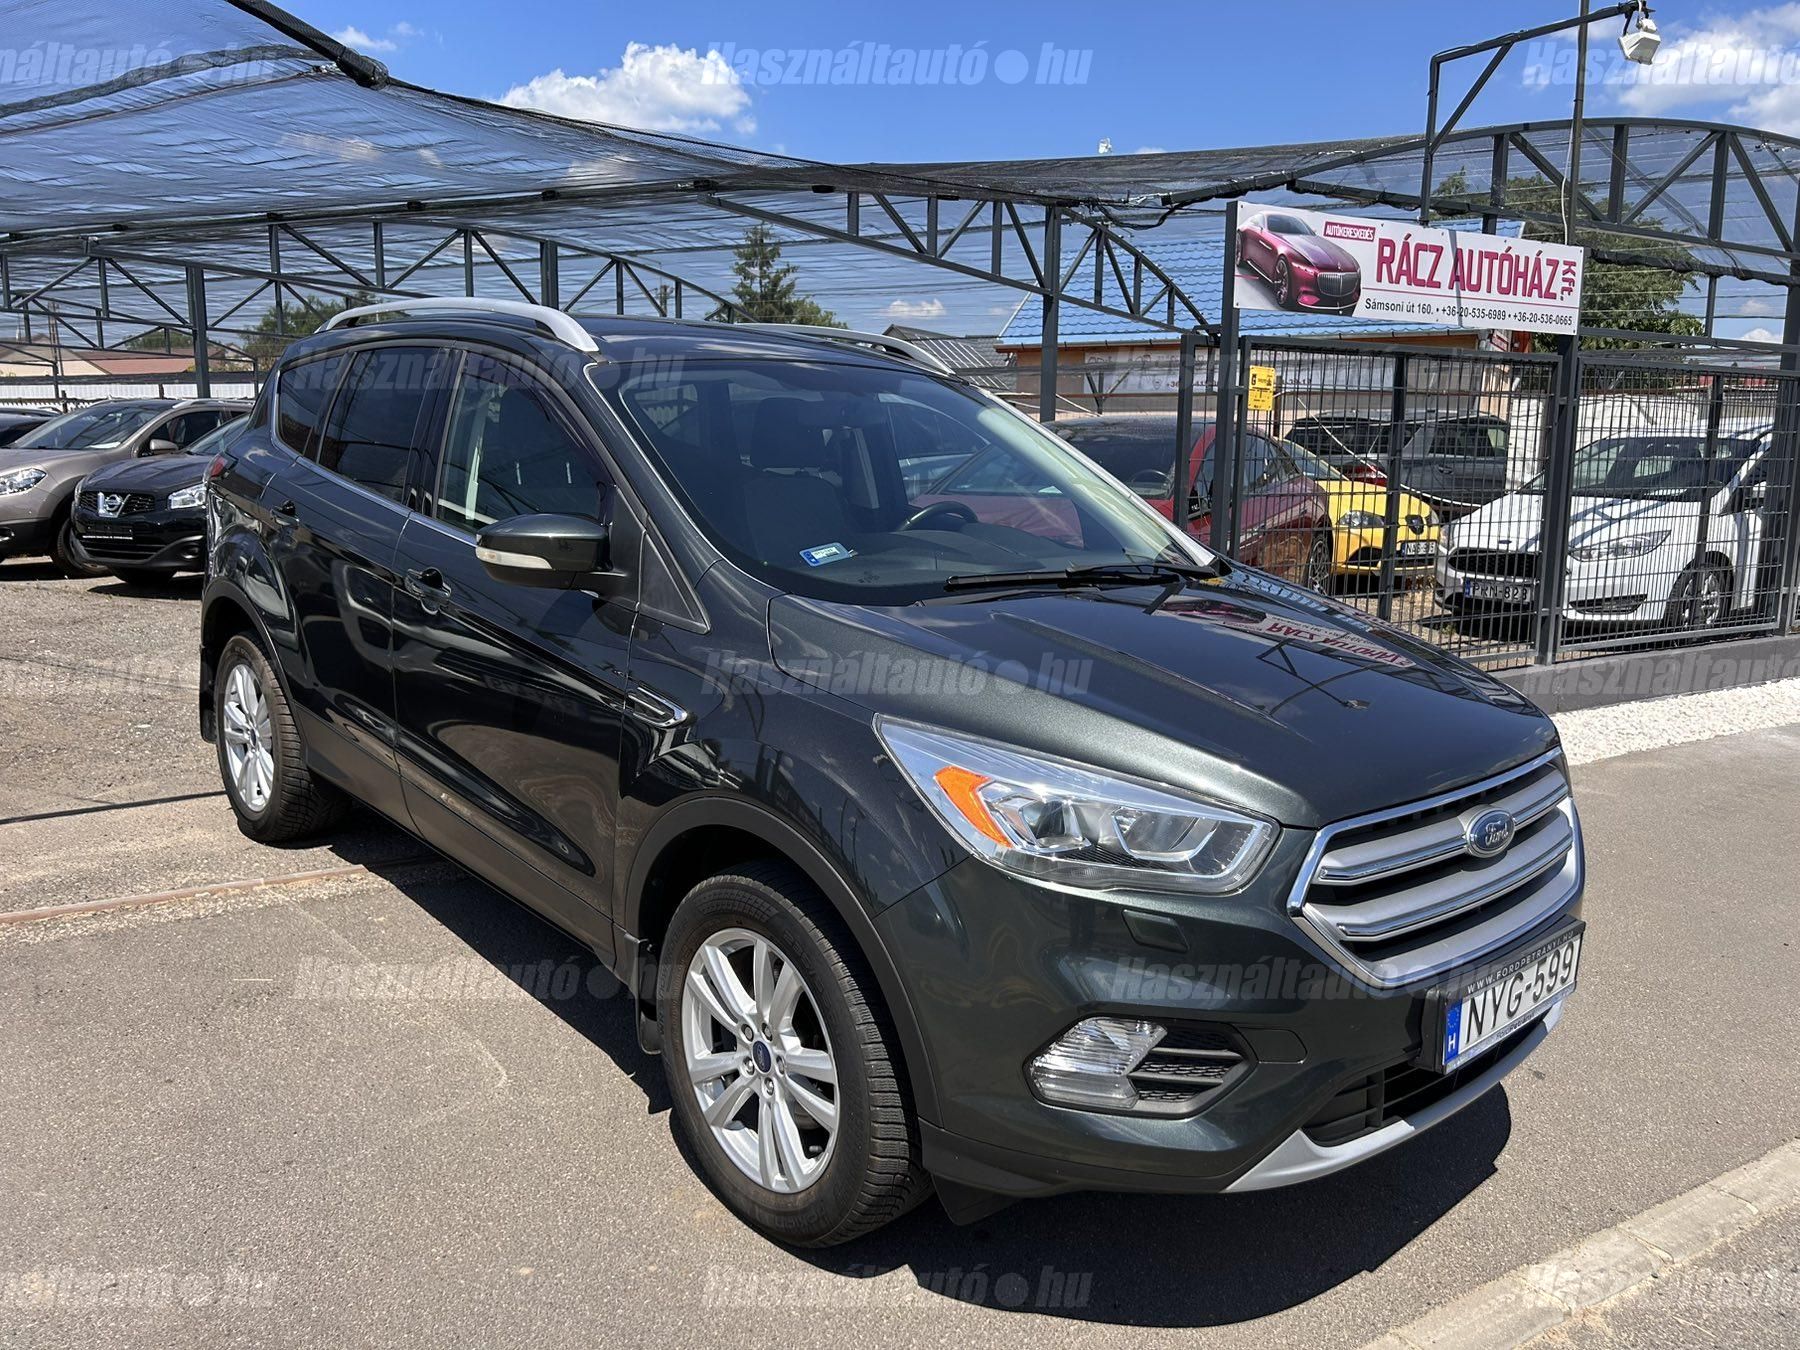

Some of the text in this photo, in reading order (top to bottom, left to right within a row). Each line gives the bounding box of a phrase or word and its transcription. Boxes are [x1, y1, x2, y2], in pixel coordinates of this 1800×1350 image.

[1376, 233, 1560, 301] RÁCZ AUTÓHÁZ
[1560, 259, 1577, 301] Kft.
[1365, 298, 1573, 326] Sámsoni út 160. +36-20-535-6989 +36-20-536-0665
[1485, 821, 1508, 846] Ford
[1465, 940, 1575, 1044] NYG-599
